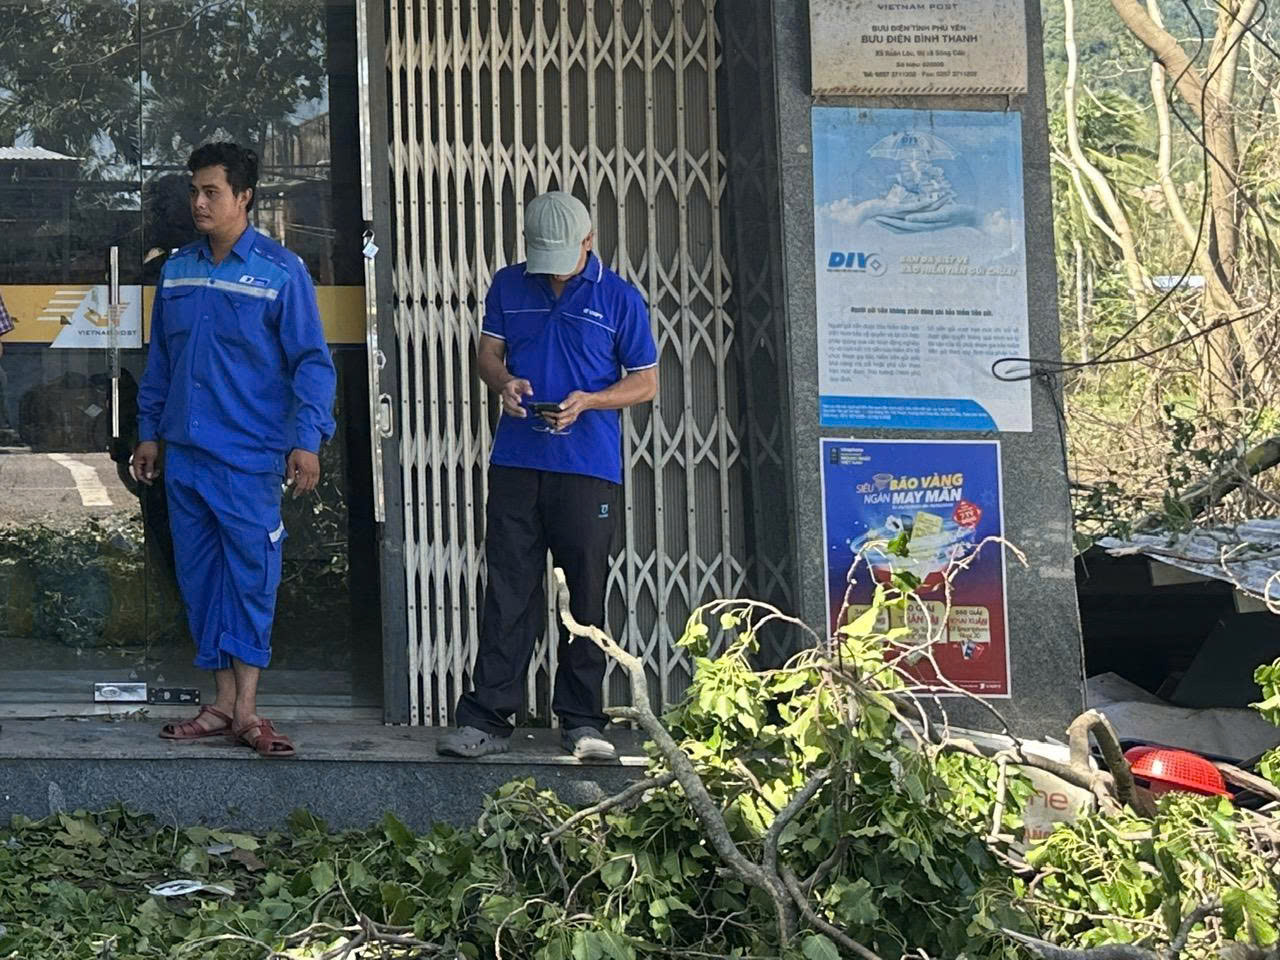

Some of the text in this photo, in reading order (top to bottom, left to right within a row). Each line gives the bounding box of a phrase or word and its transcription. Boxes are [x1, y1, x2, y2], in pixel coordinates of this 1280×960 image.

[828, 251, 869, 269] DIV
[921, 472, 963, 489] VÀNG
[892, 491, 925, 505] MAY
